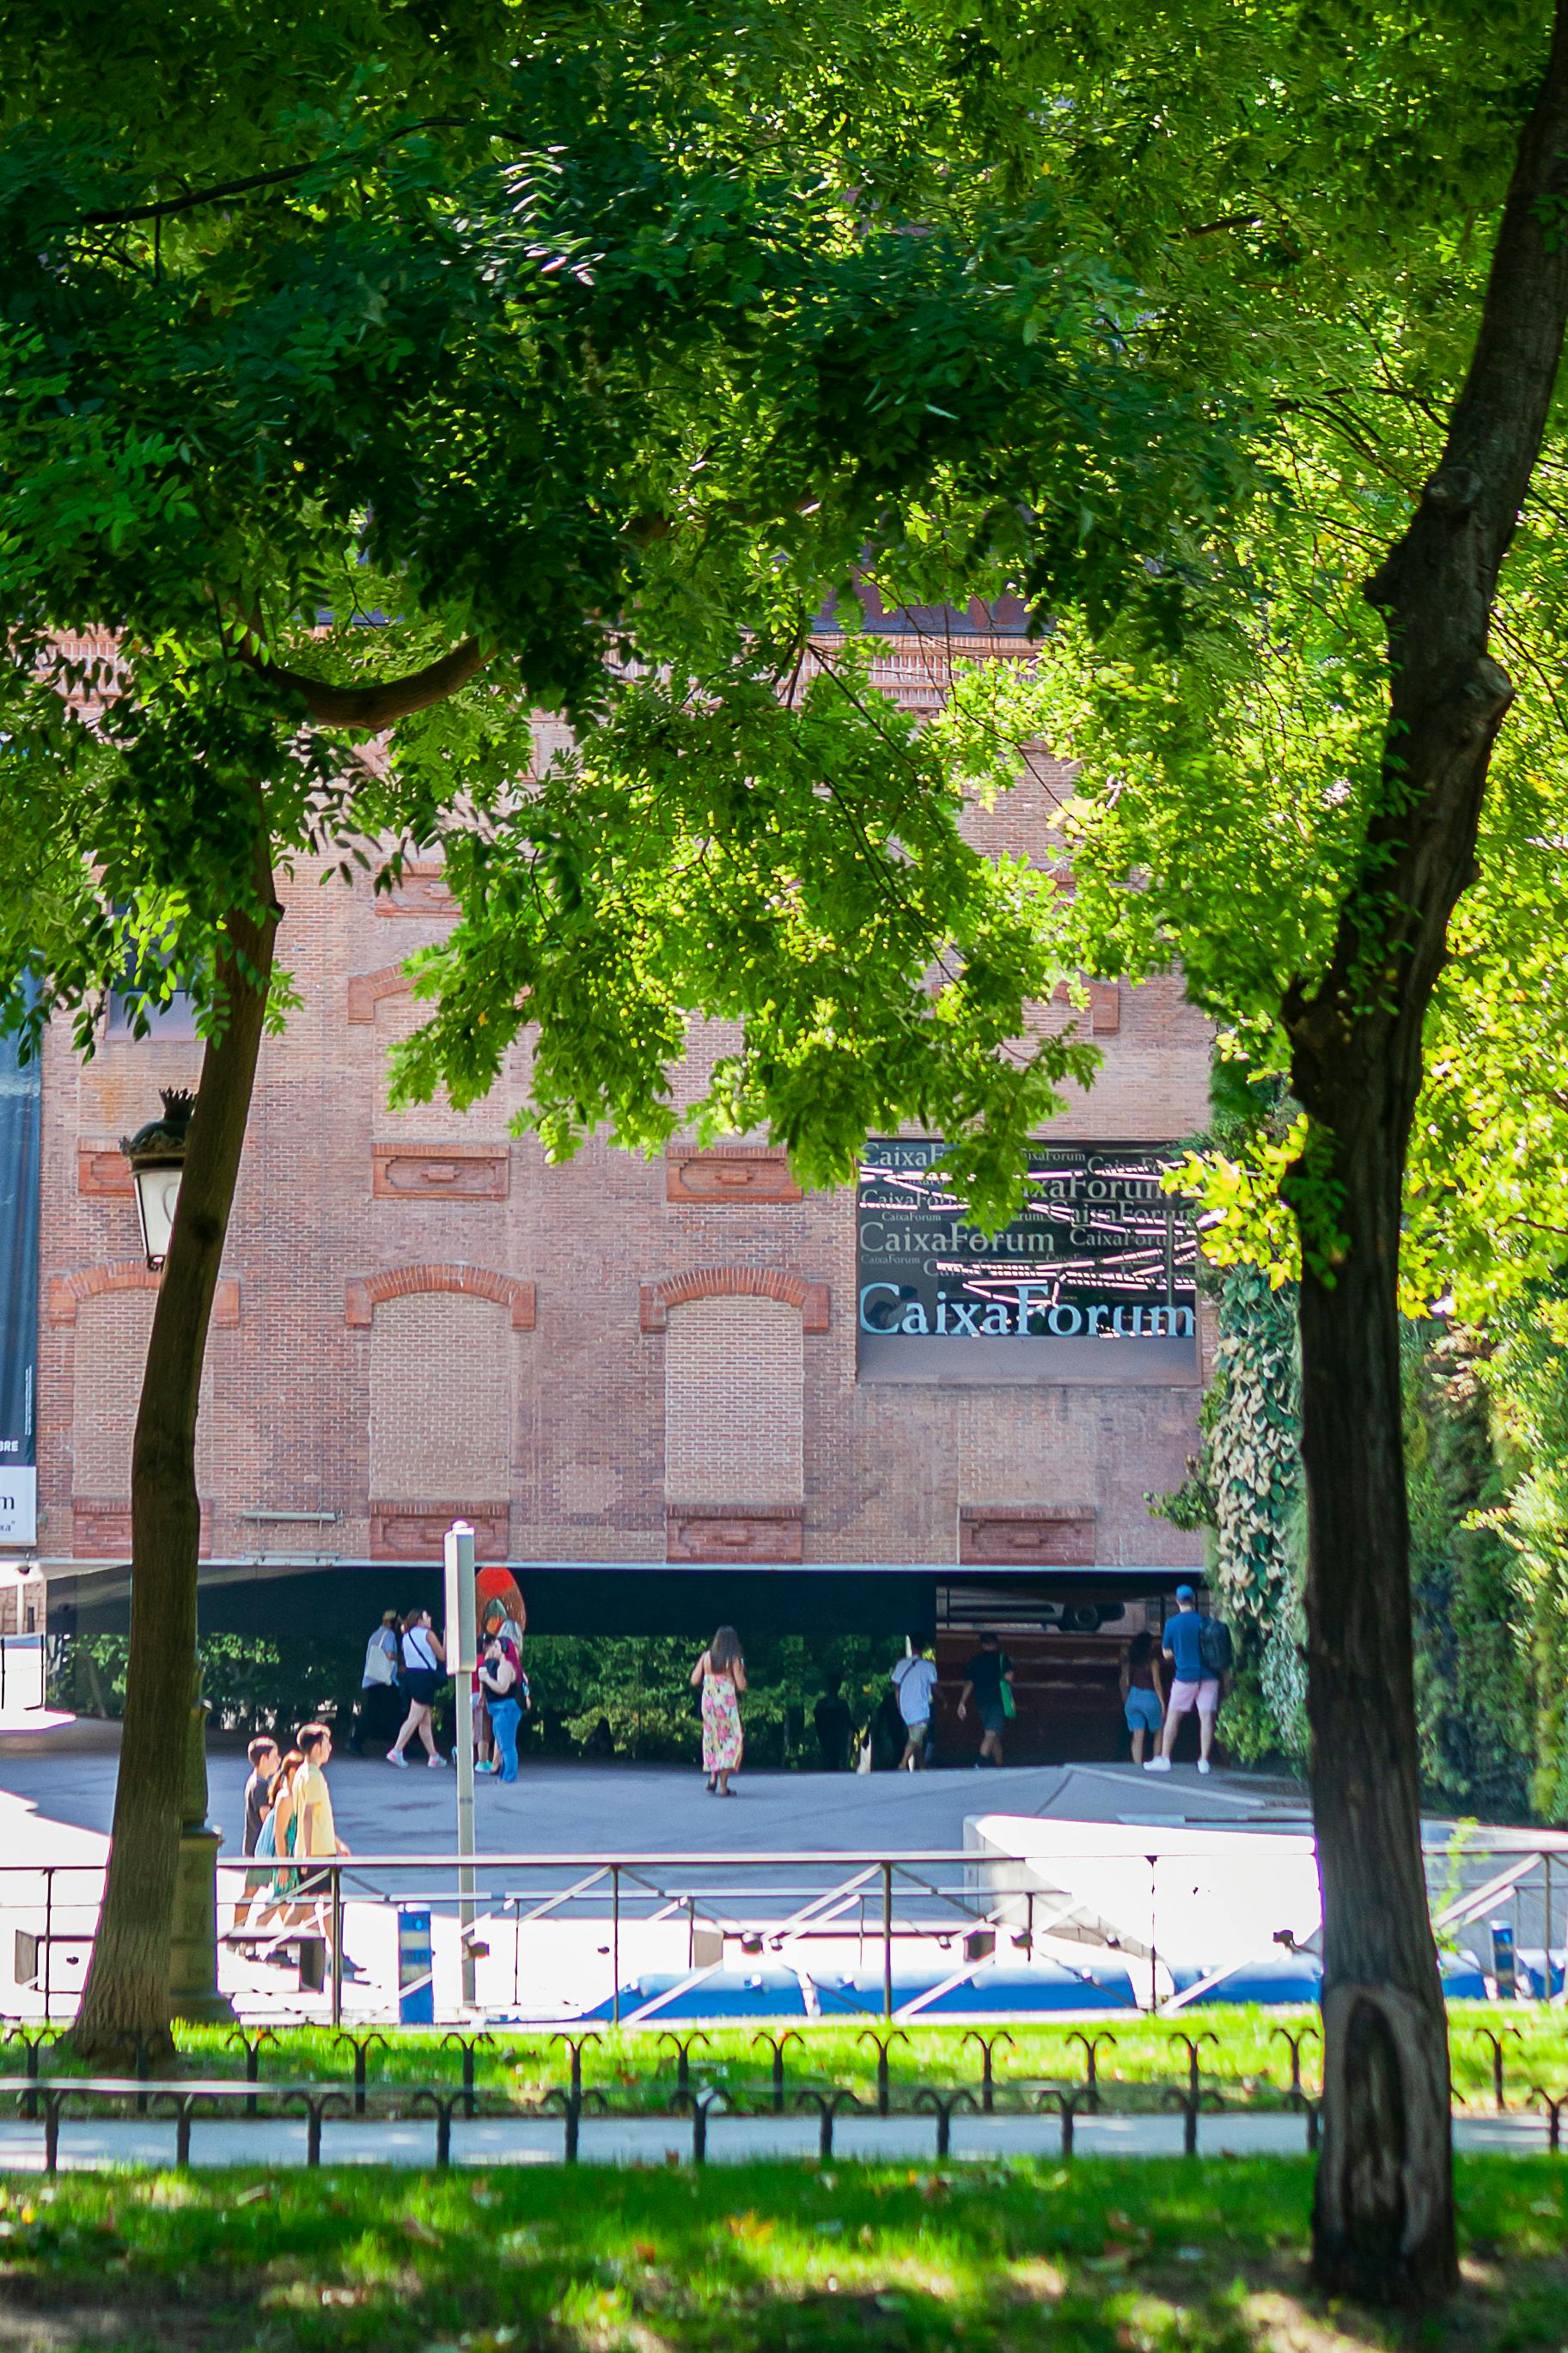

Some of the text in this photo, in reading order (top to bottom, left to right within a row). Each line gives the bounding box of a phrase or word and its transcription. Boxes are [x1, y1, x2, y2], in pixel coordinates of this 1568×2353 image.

[861, 1142, 946, 1166] CaixaF
[882, 1211, 941, 1221] CaixaForum
[860, 1221, 1054, 1252] CaixaForum
[861, 1254, 920, 1264] CaixaForum
[860, 1282, 1195, 1338] CaixaForum
